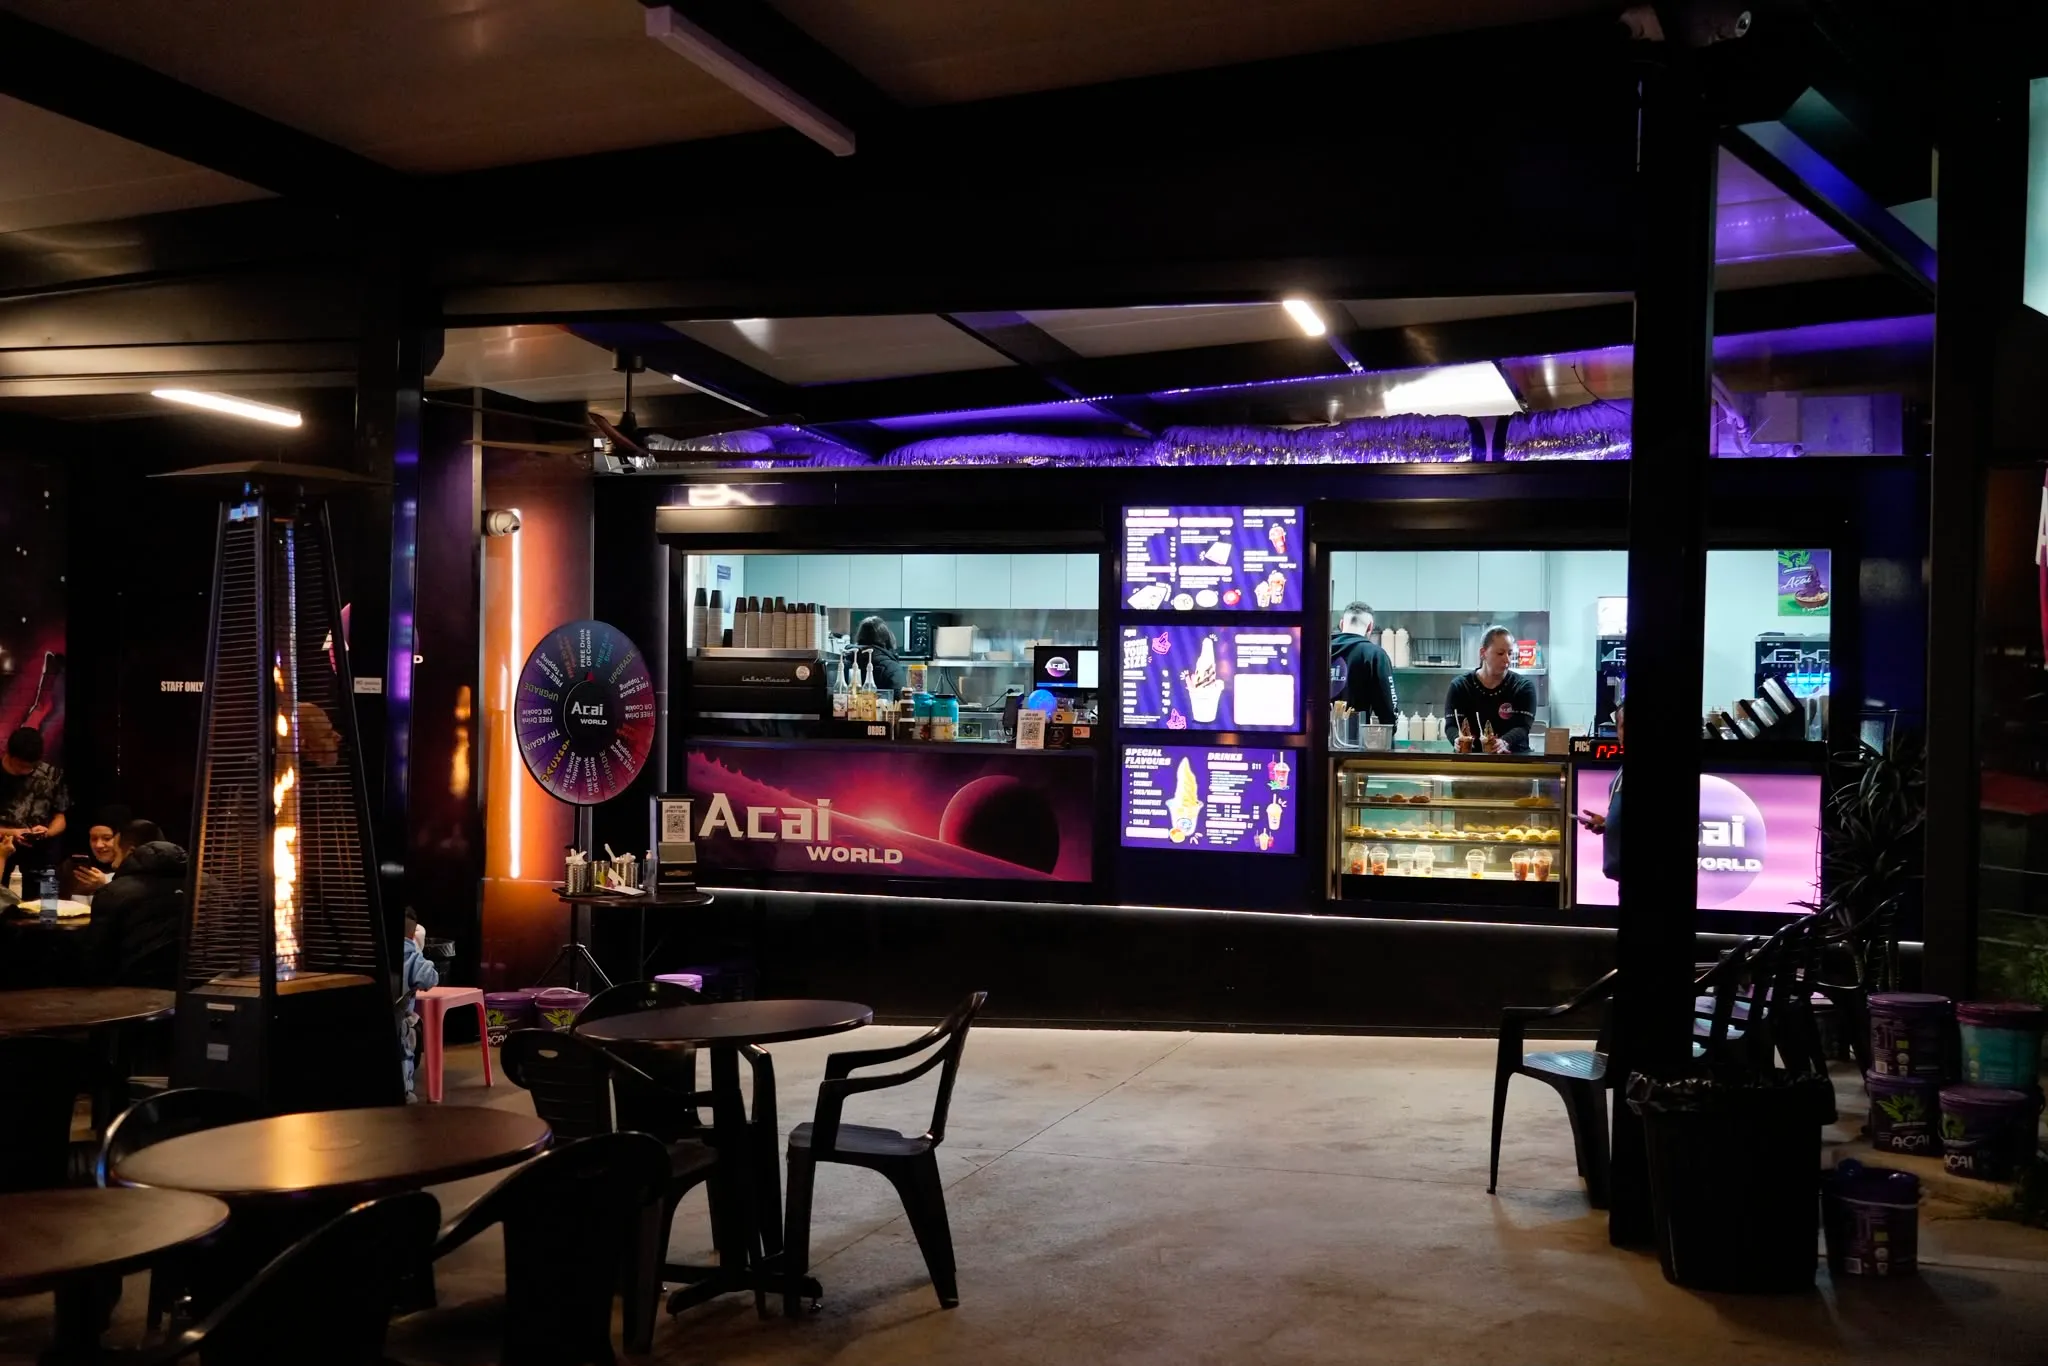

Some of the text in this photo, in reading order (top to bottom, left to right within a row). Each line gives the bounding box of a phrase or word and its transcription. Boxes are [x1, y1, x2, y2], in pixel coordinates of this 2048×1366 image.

[541, 652, 560, 675] Topping
[609, 650, 635, 684] UPGRADE
[1124, 656, 1147, 669] SIZE
[536, 658, 563, 687] FREE Sauce
[161, 681, 204, 692] STAFF ONLY
[525, 682, 559, 701] UPGRADE
[620, 678, 640, 690] Topping
[620, 682, 648, 698] FREE Sauce
[571, 702, 604, 716] Acai
[867, 725, 886, 736] ORDER
[525, 729, 560, 751] TRY AGAIN
[610, 745, 624, 761] Sauce
[616, 739, 634, 762] Topping
[1125, 748, 1162, 757] SPECIAL
[1208, 752, 1243, 761] DRINKS
[567, 752, 575, 773] Sauce
[1125, 757, 1171, 765] FLAVOURS
[571, 756, 581, 784] Topping
[600, 750, 616, 792] UPGRADE
[594, 782, 599, 792] OR
[698, 792, 832, 841] Acai
[1699, 815, 1745, 847] ai
[807, 846, 903, 864] WORLD
[1698, 857, 1763, 872] ORLD
[1892, 1135, 1930, 1150] AÇAI
